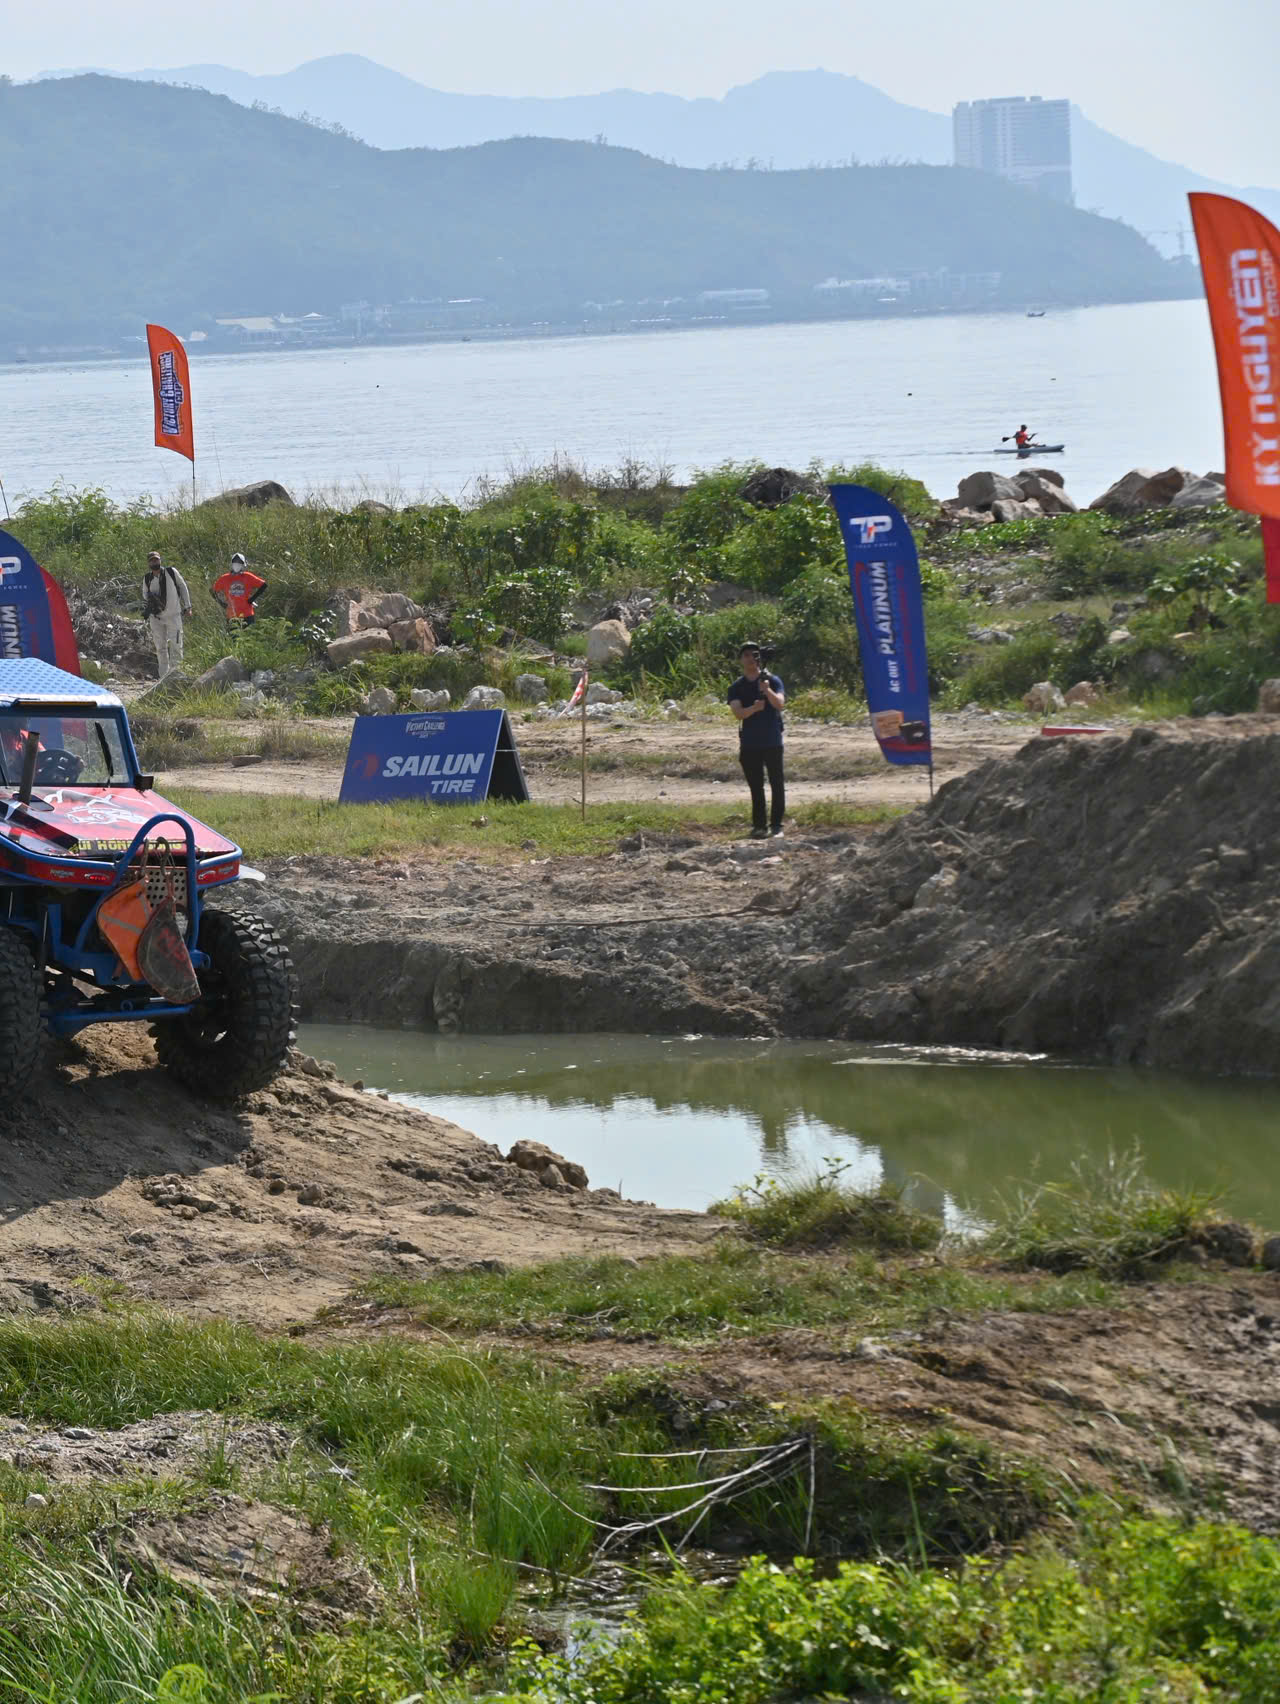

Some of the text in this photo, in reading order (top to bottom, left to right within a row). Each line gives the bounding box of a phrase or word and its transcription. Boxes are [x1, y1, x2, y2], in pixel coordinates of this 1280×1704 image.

[849, 515, 892, 544] TP
[871, 561, 895, 655] PLATINUM
[383, 753, 485, 777] SAILUN
[431, 779, 476, 794] TIRE
